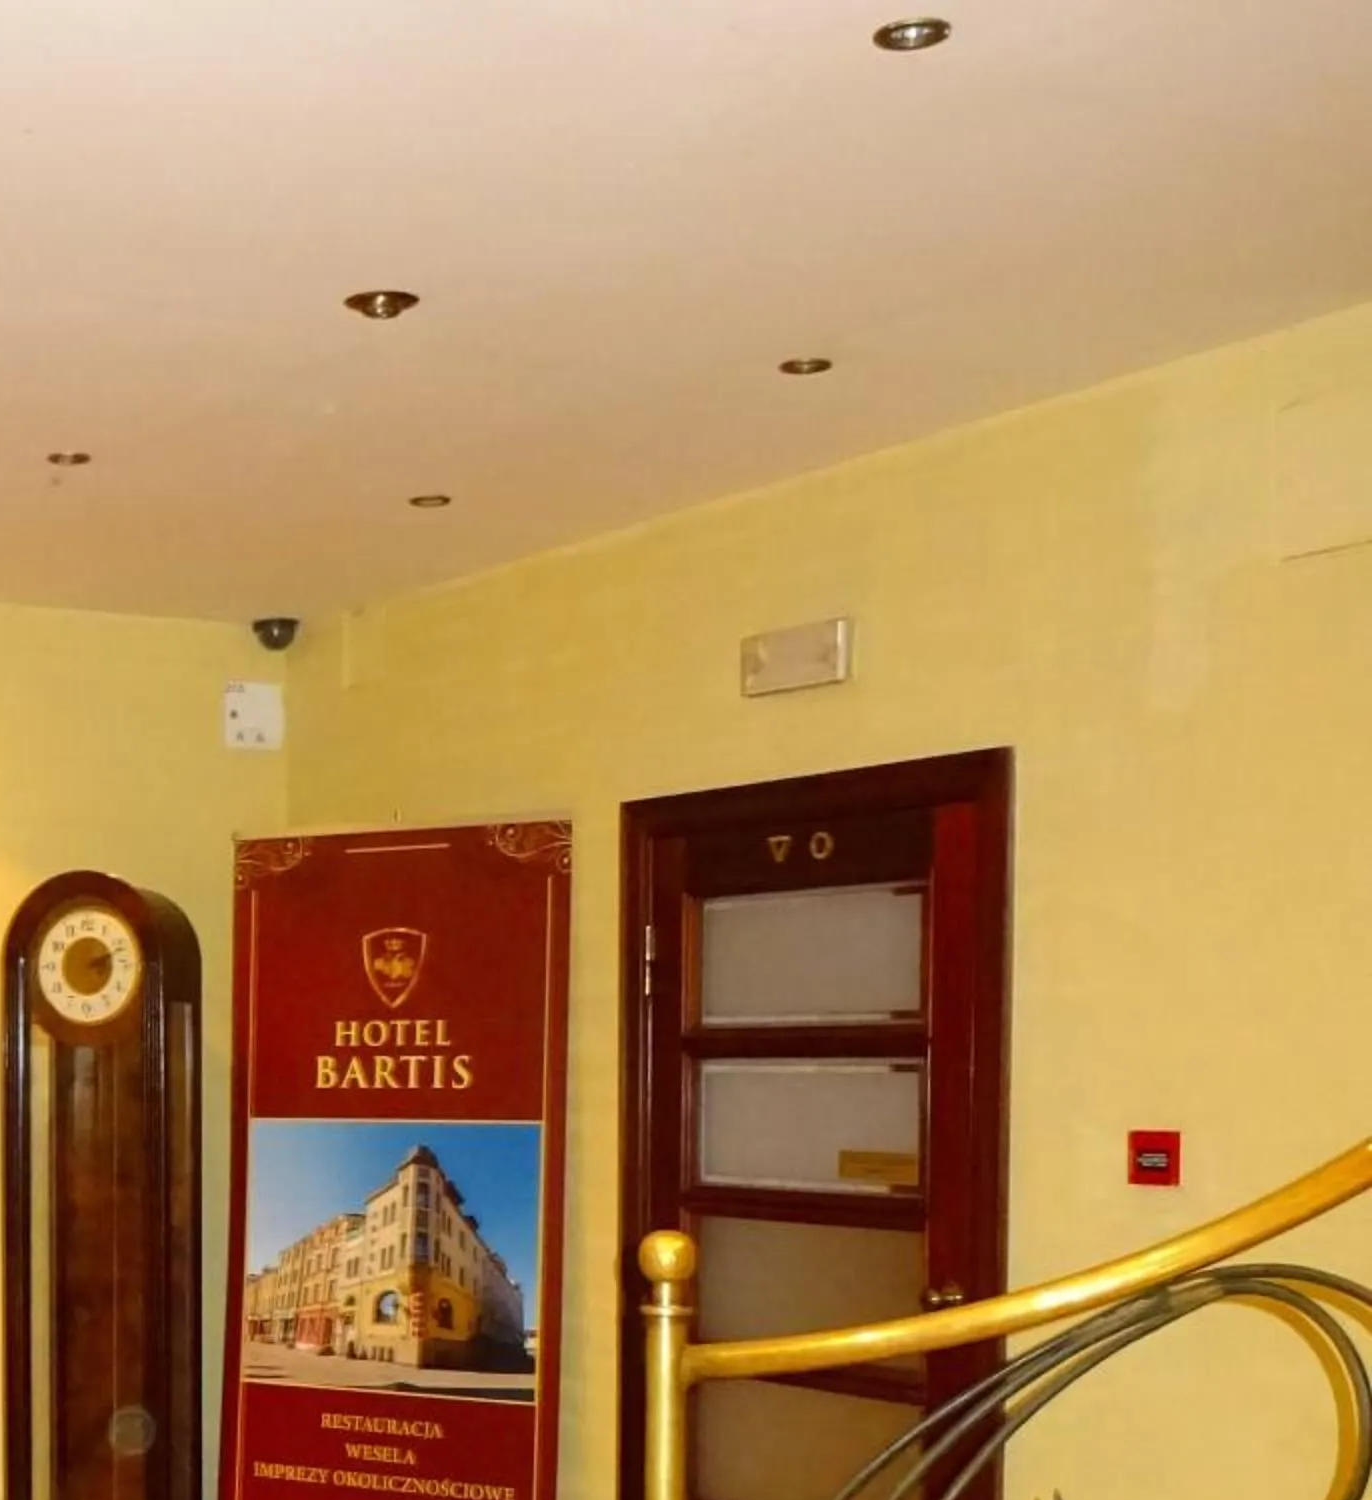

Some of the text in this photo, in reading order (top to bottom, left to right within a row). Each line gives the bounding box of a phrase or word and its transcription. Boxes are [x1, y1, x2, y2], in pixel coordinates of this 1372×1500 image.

[334, 1019, 452, 1047] HOTEL
[315, 1055, 473, 1090] BARTIS
[320, 1412, 444, 1440] RESTAURACJA
[344, 1441, 417, 1466] WESELA
[253, 1460, 330, 1485] IMPREZY
